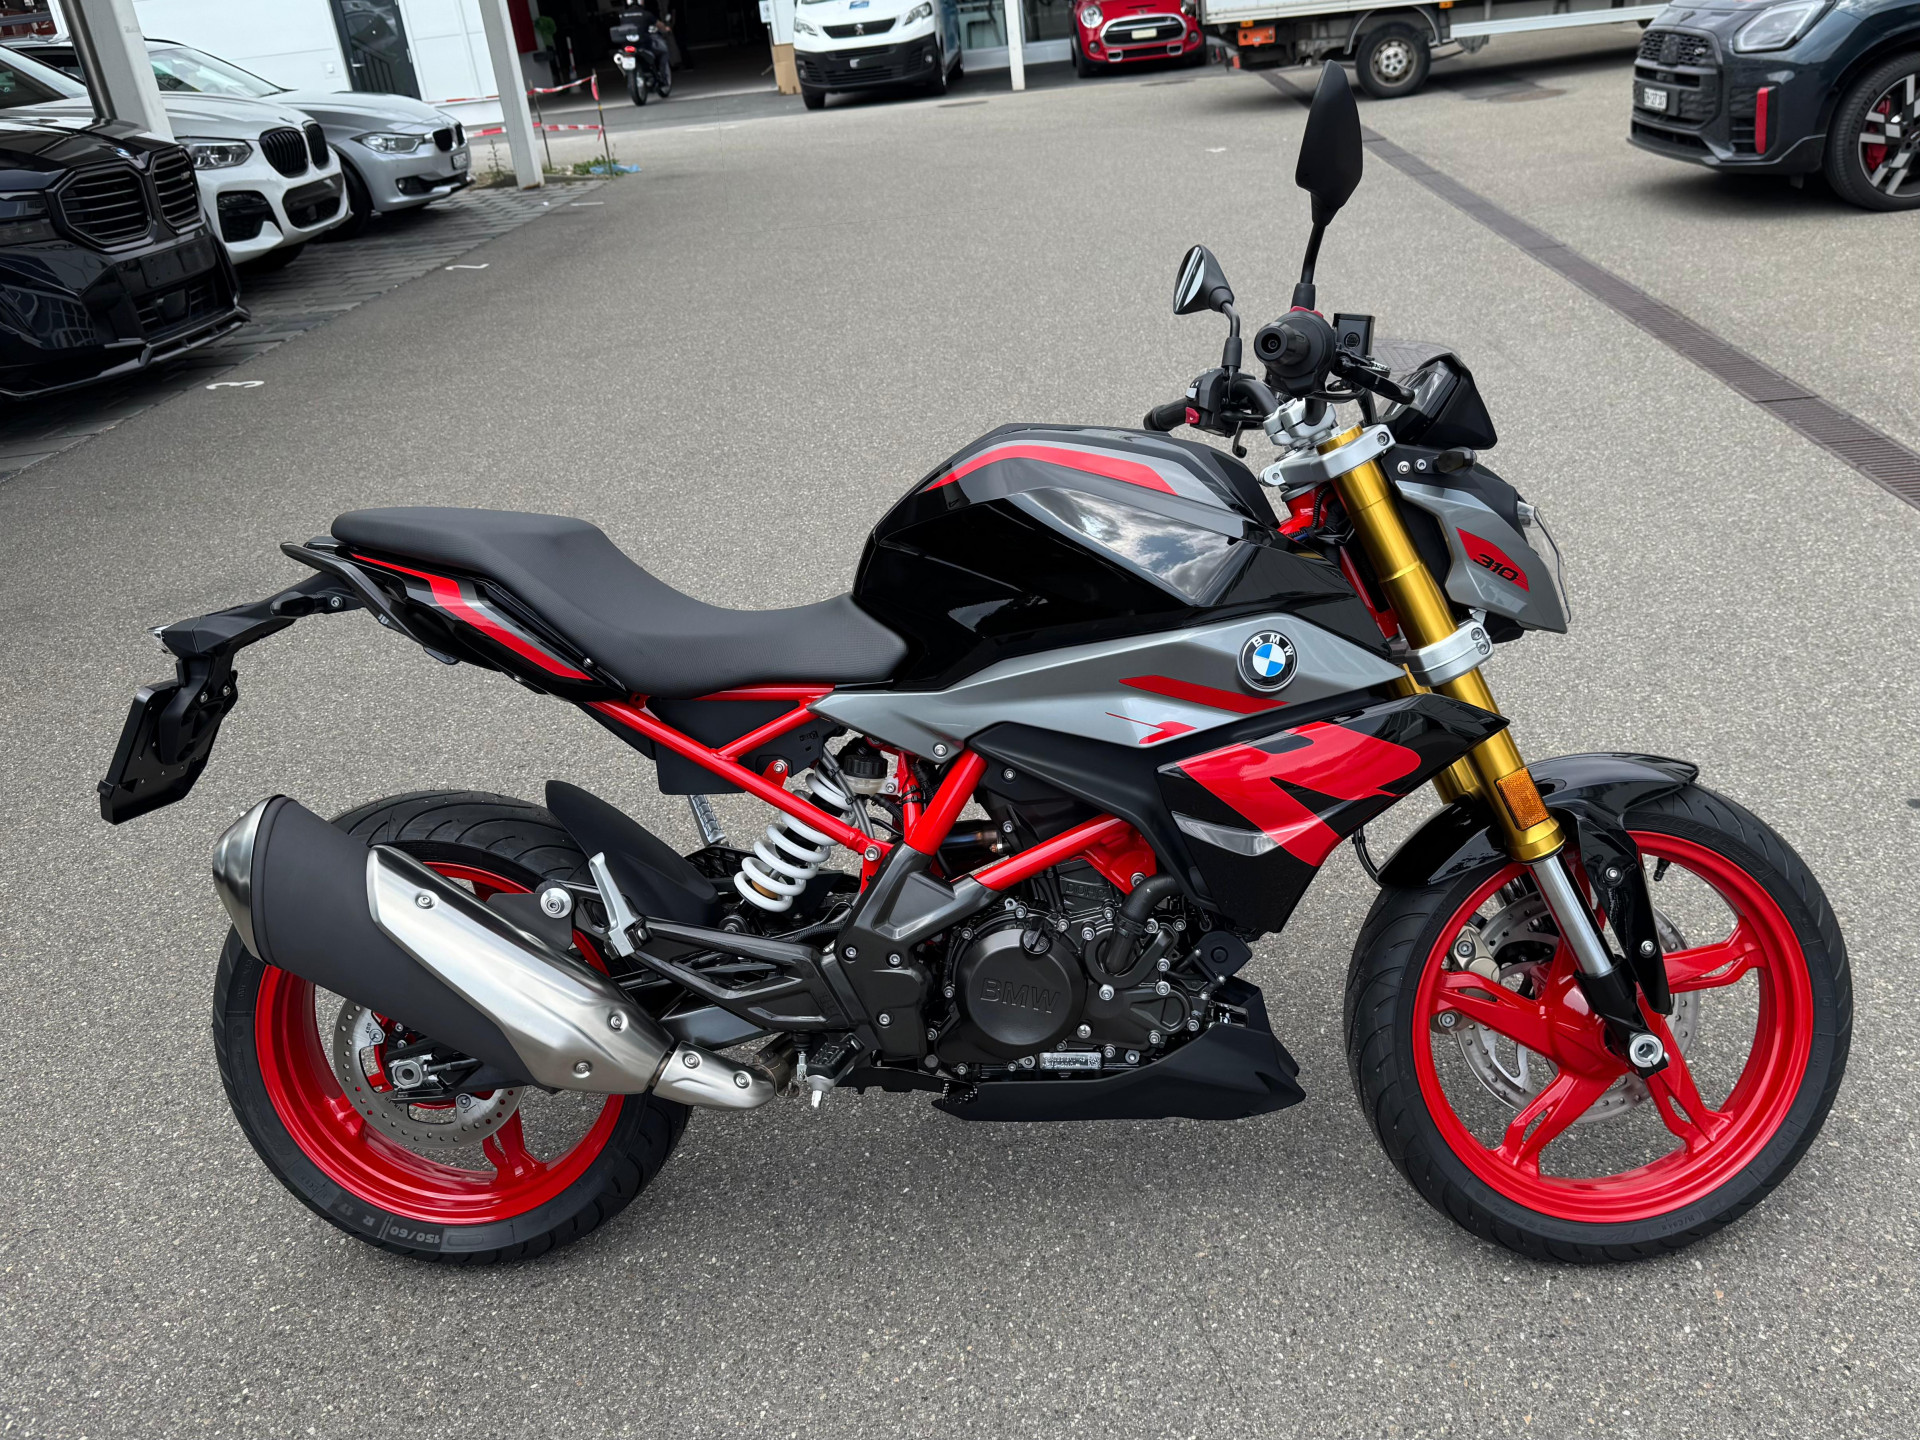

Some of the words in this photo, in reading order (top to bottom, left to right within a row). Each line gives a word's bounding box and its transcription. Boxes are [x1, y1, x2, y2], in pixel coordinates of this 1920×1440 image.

[1473, 553, 1519, 581] 310
[1252, 634, 1294, 656] BMW
[980, 977, 1061, 1013] BMW
[362, 1215, 376, 1227] R
[389, 1226, 441, 1244] 150/60
